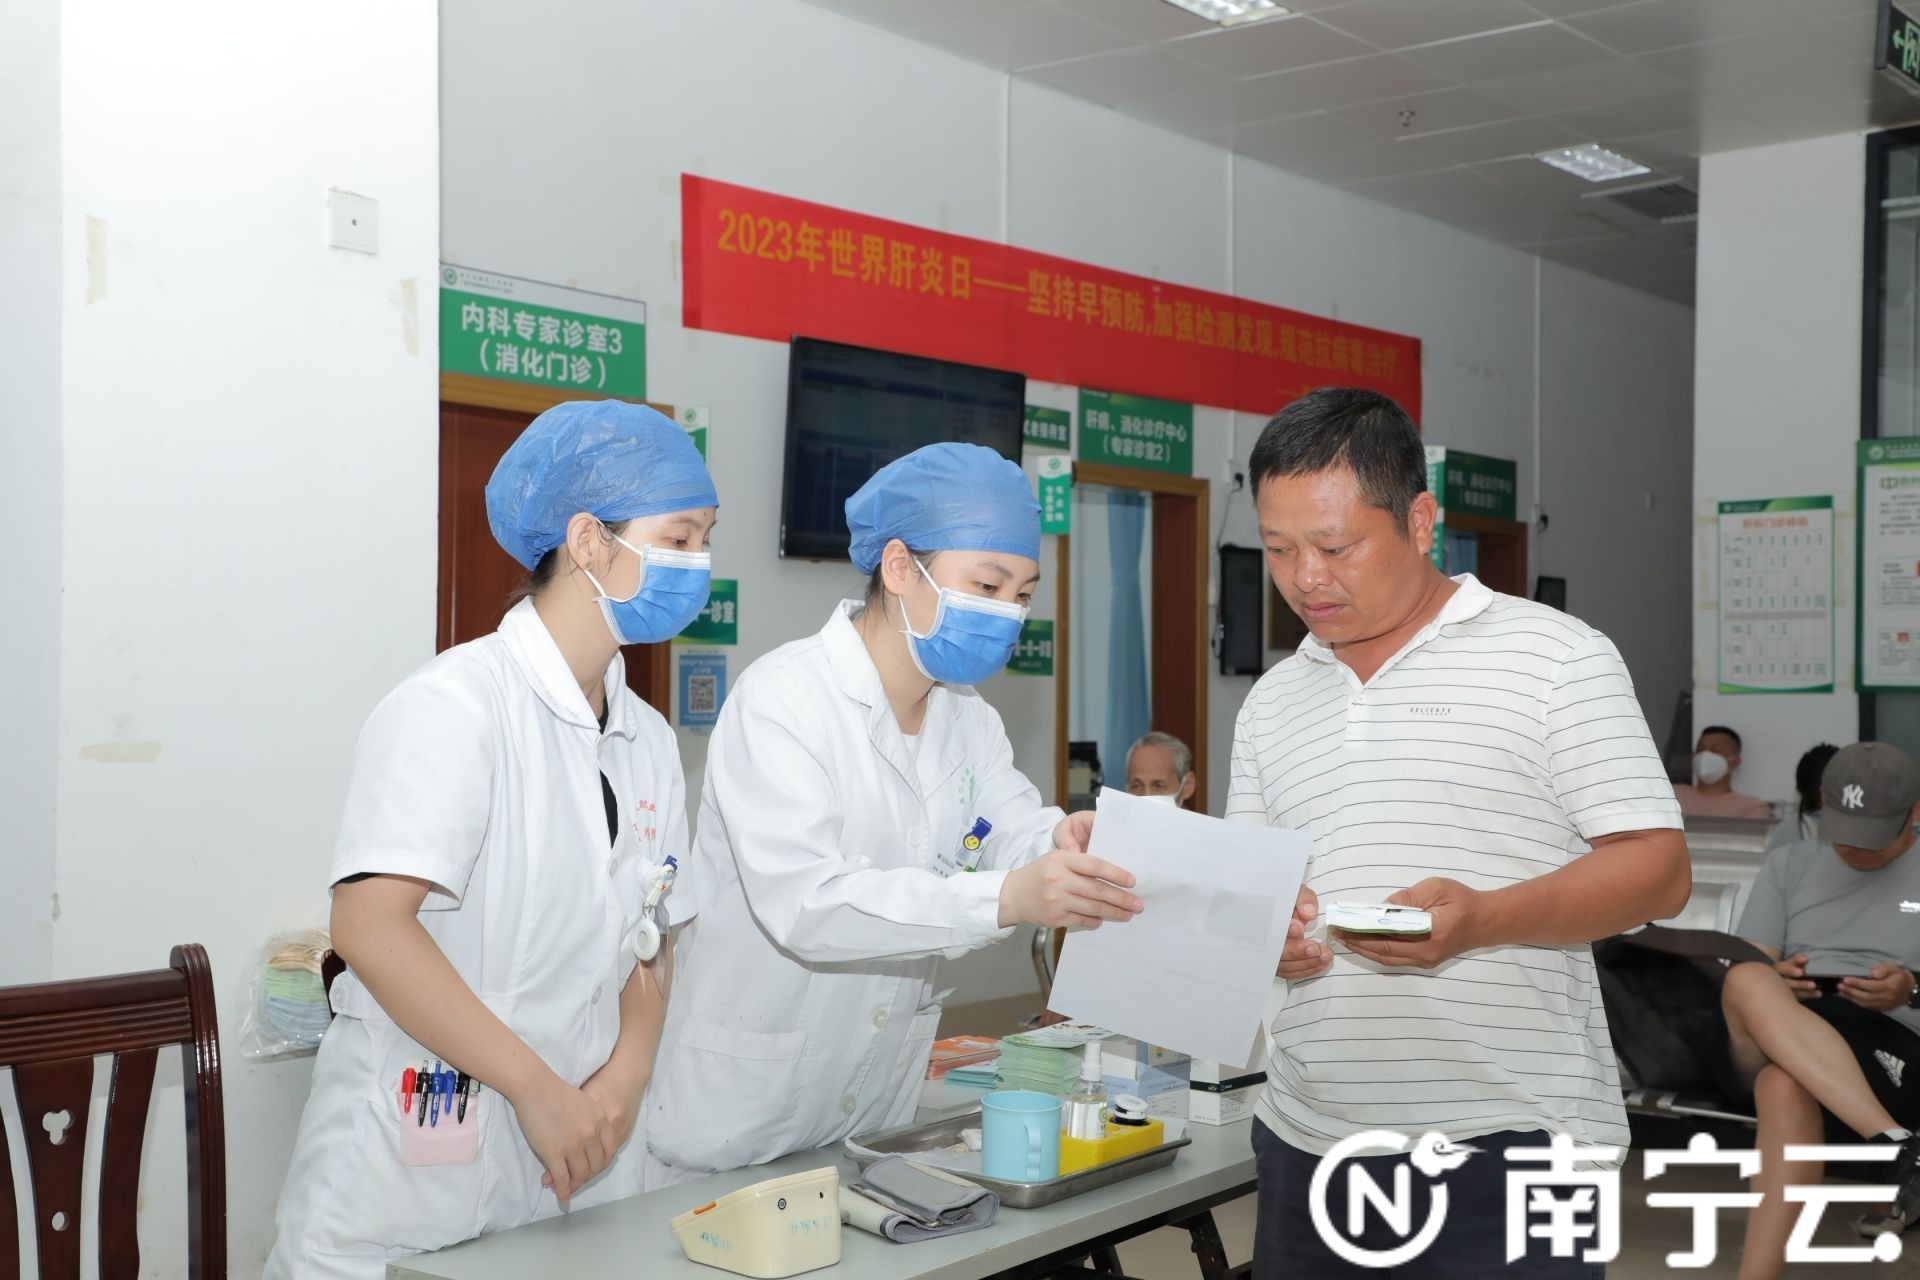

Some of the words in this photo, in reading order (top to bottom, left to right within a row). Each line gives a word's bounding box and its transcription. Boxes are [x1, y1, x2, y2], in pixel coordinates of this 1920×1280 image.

[461, 301, 623, 355] 内科专家诊室3
